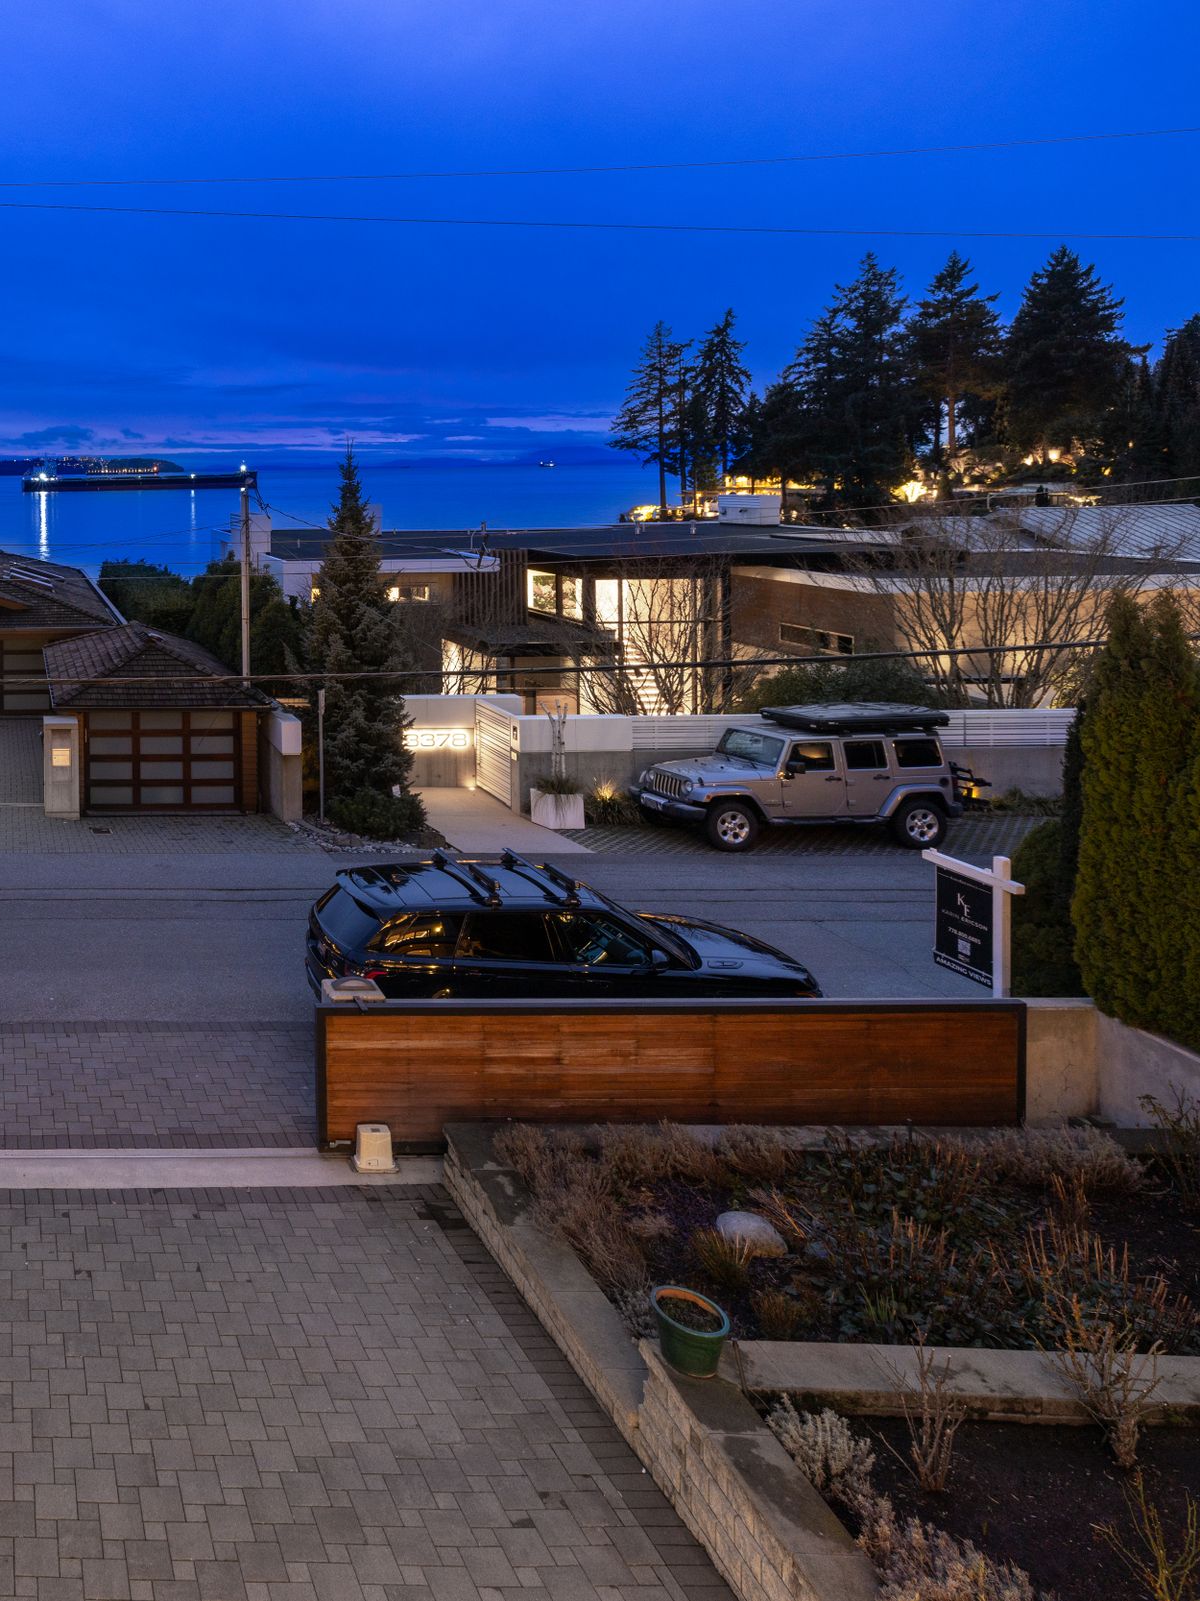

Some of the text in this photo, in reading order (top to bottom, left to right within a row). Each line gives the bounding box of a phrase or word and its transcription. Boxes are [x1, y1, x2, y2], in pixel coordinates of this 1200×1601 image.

[406, 733, 467, 747] 3378
[936, 956, 968, 975] AMAZING
[968, 970, 992, 985] VIEWS
